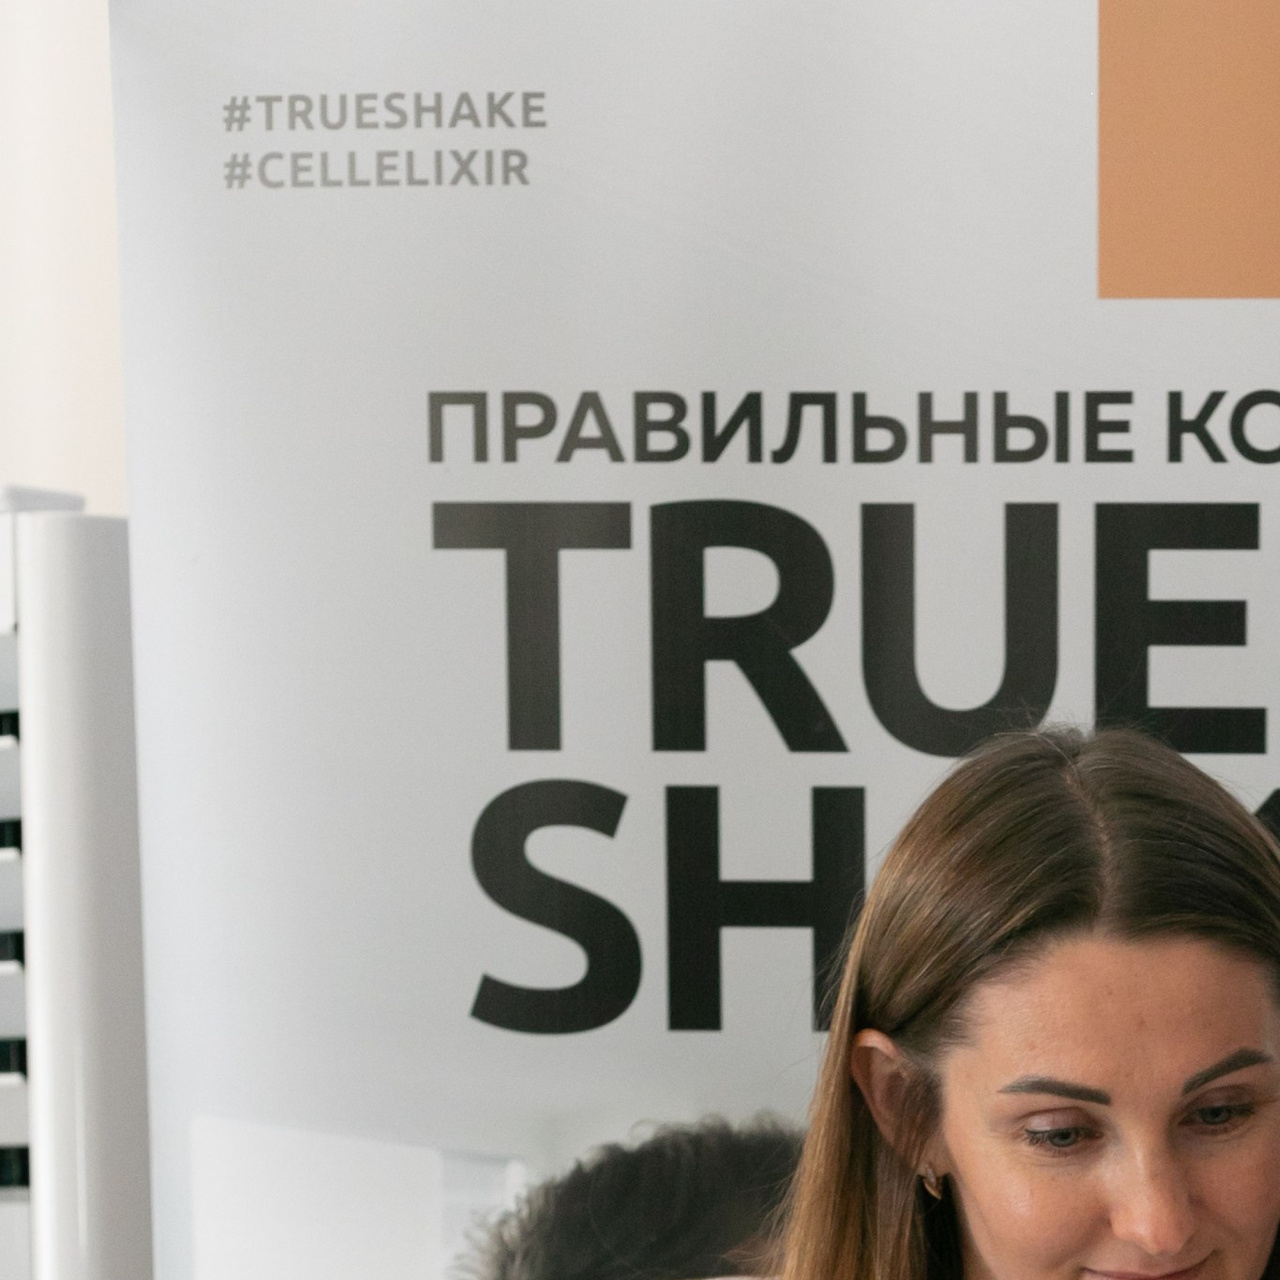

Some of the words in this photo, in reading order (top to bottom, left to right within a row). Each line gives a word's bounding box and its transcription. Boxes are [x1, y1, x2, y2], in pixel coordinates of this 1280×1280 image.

[222, 91, 547, 131] #TRUESHAKE
[223, 149, 531, 190] #CELLELIXIR
[427, 390, 1135, 465] ПРАВИЛЬНЫЕ
[432, 498, 1268, 757] TRUE
